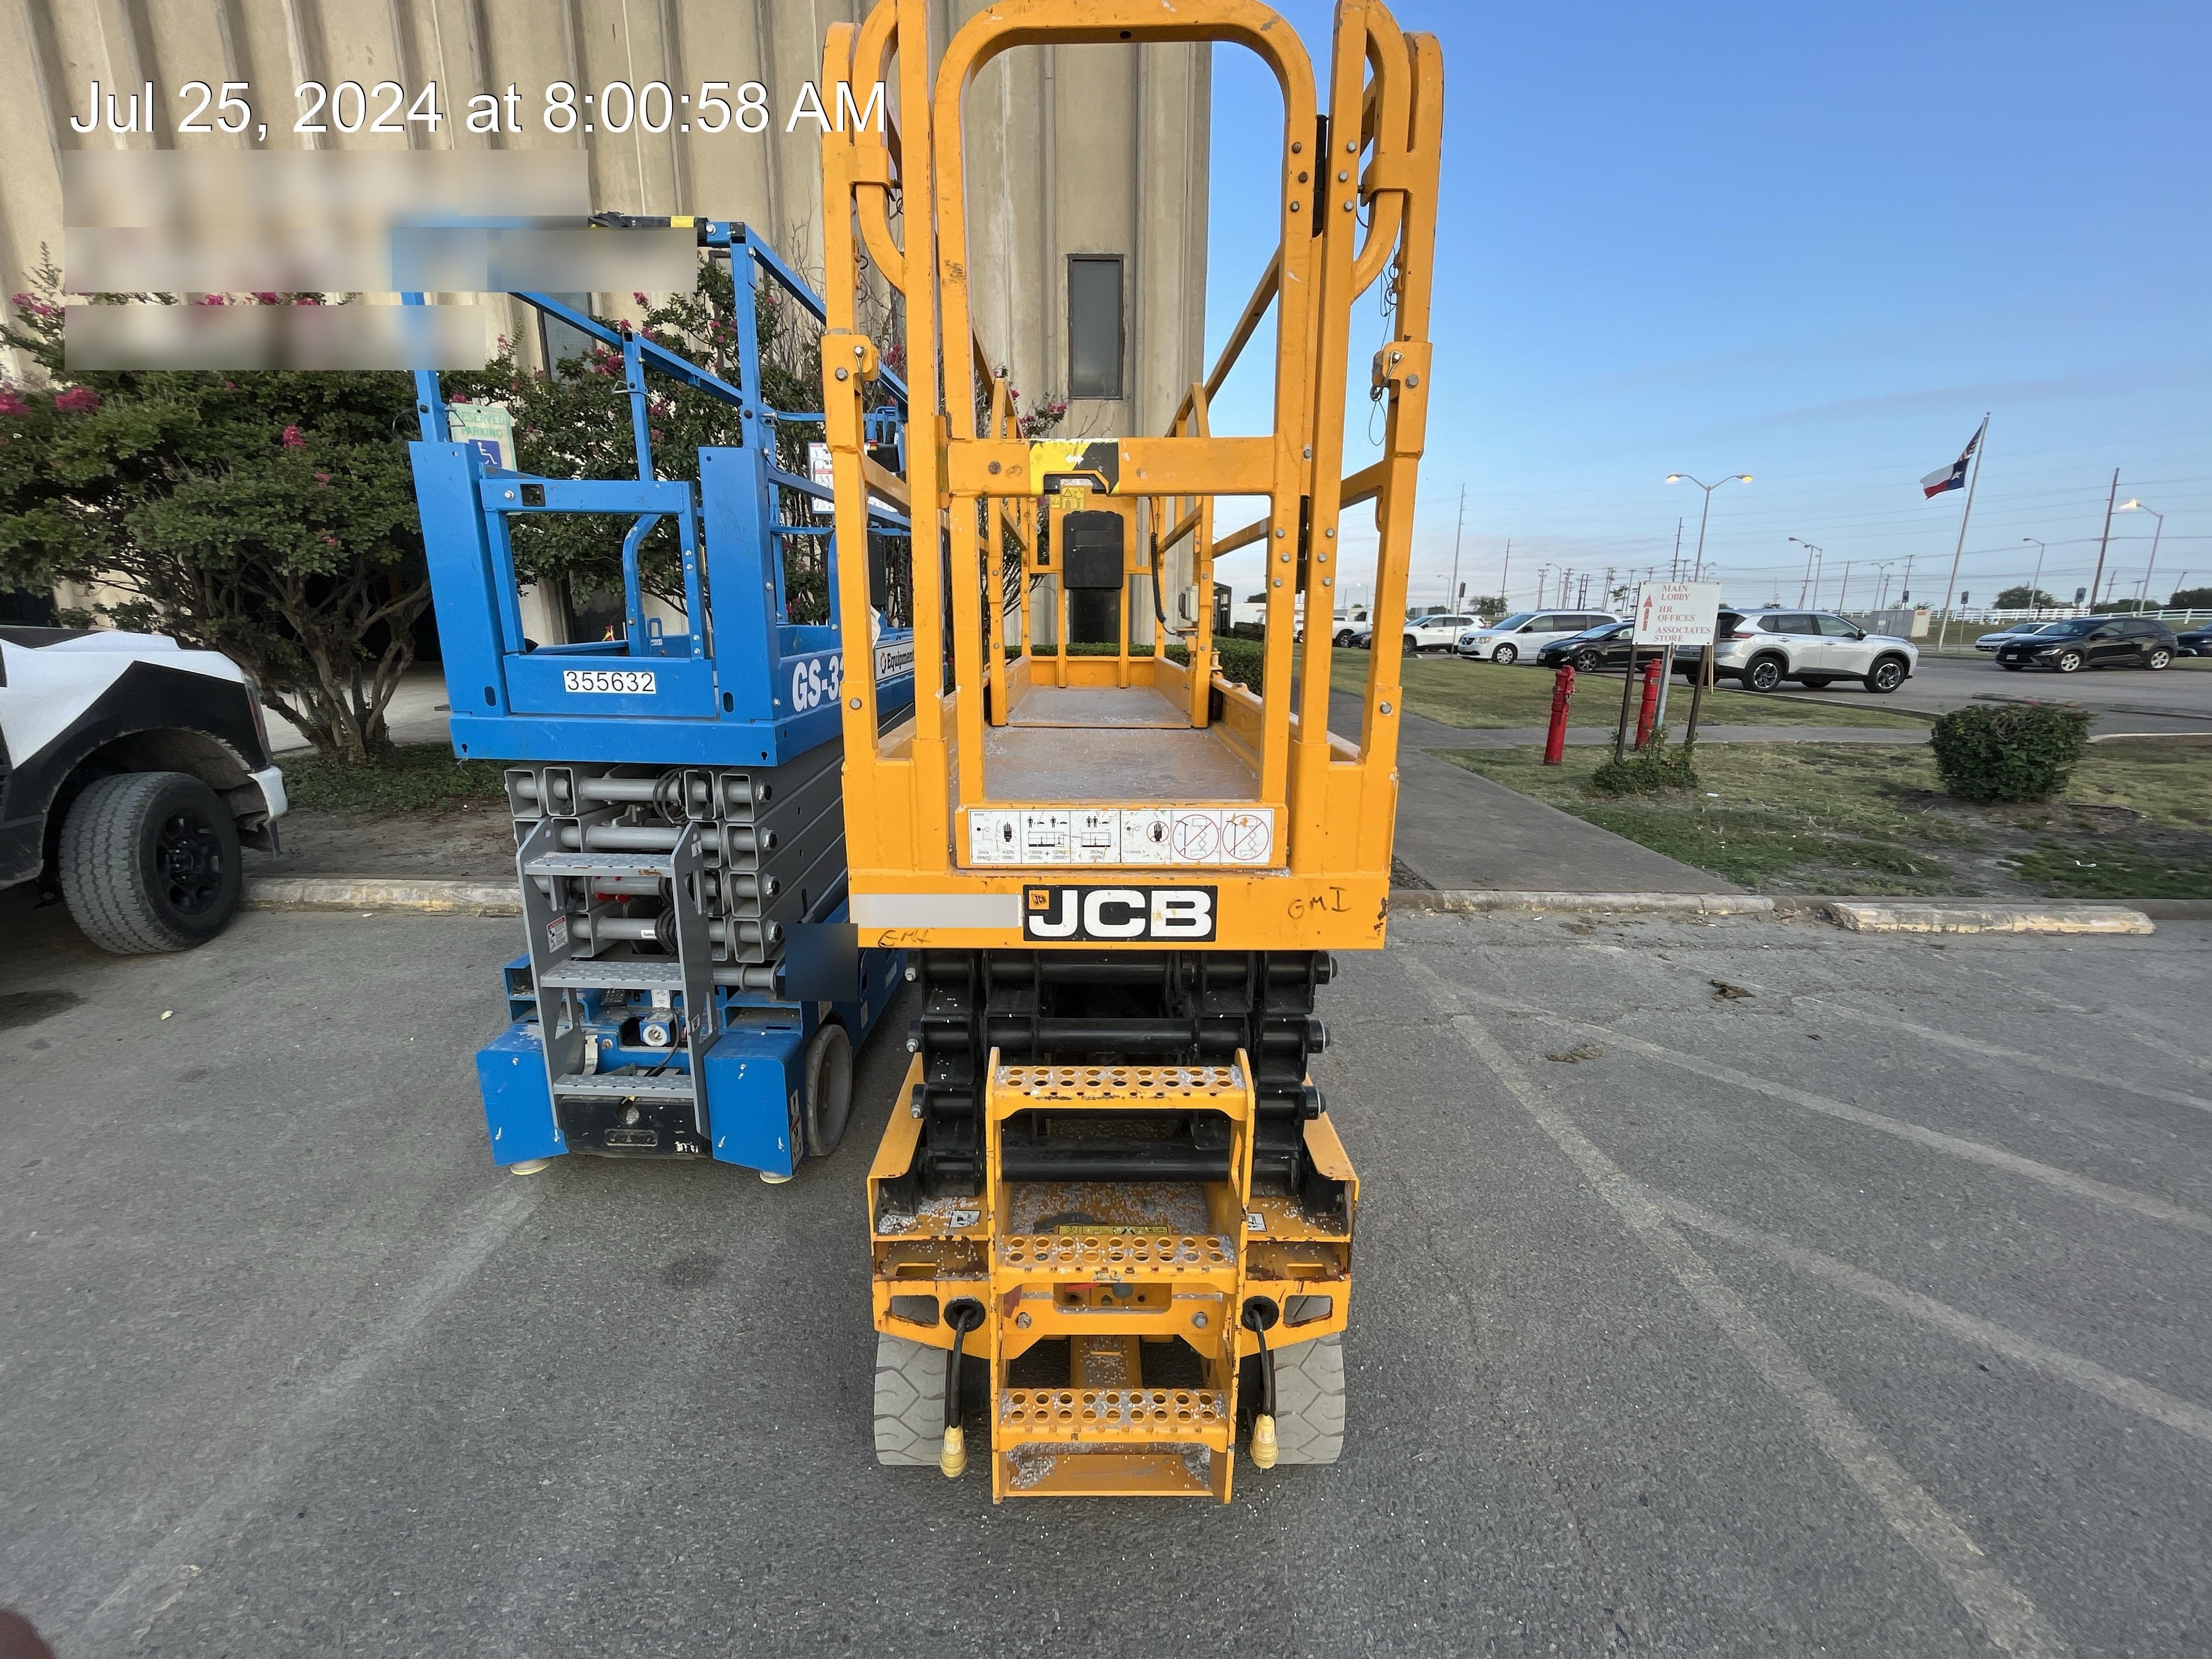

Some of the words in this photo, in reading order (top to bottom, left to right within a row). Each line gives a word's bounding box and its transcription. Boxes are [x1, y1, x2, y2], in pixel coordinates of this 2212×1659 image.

[462, 426, 503, 439] PARKING
[566, 671, 654, 692] 355632
[792, 656, 844, 712] GS-3
[1029, 890, 1212, 937] JCB
[1034, 895, 1046, 905] JCB
[1288, 886, 1351, 919] GMI
